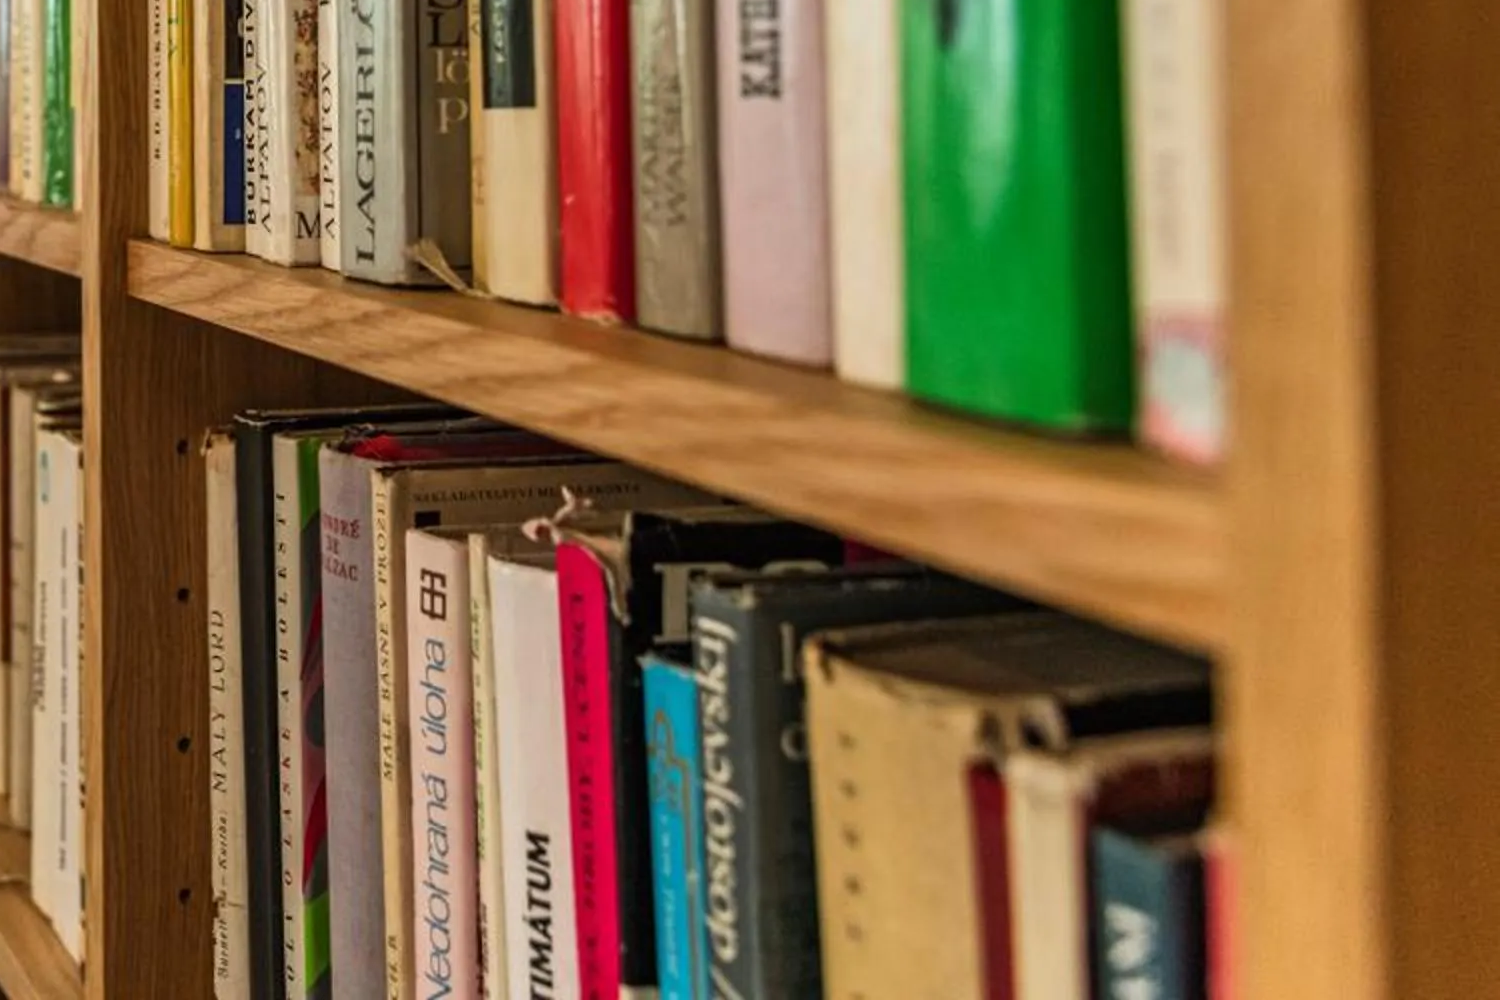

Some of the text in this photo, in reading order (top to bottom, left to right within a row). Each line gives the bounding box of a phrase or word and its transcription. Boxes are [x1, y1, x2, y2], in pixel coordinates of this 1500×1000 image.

[255, 60, 272, 234] ALPATOV
[320, 62, 337, 241] ALPATOV
[208, 608, 226, 694] LORD
[274, 491, 290, 664] BOLESTI
[417, 638, 454, 1000] Nedohraná úloha
[693, 614, 745, 964] dostojevskij
